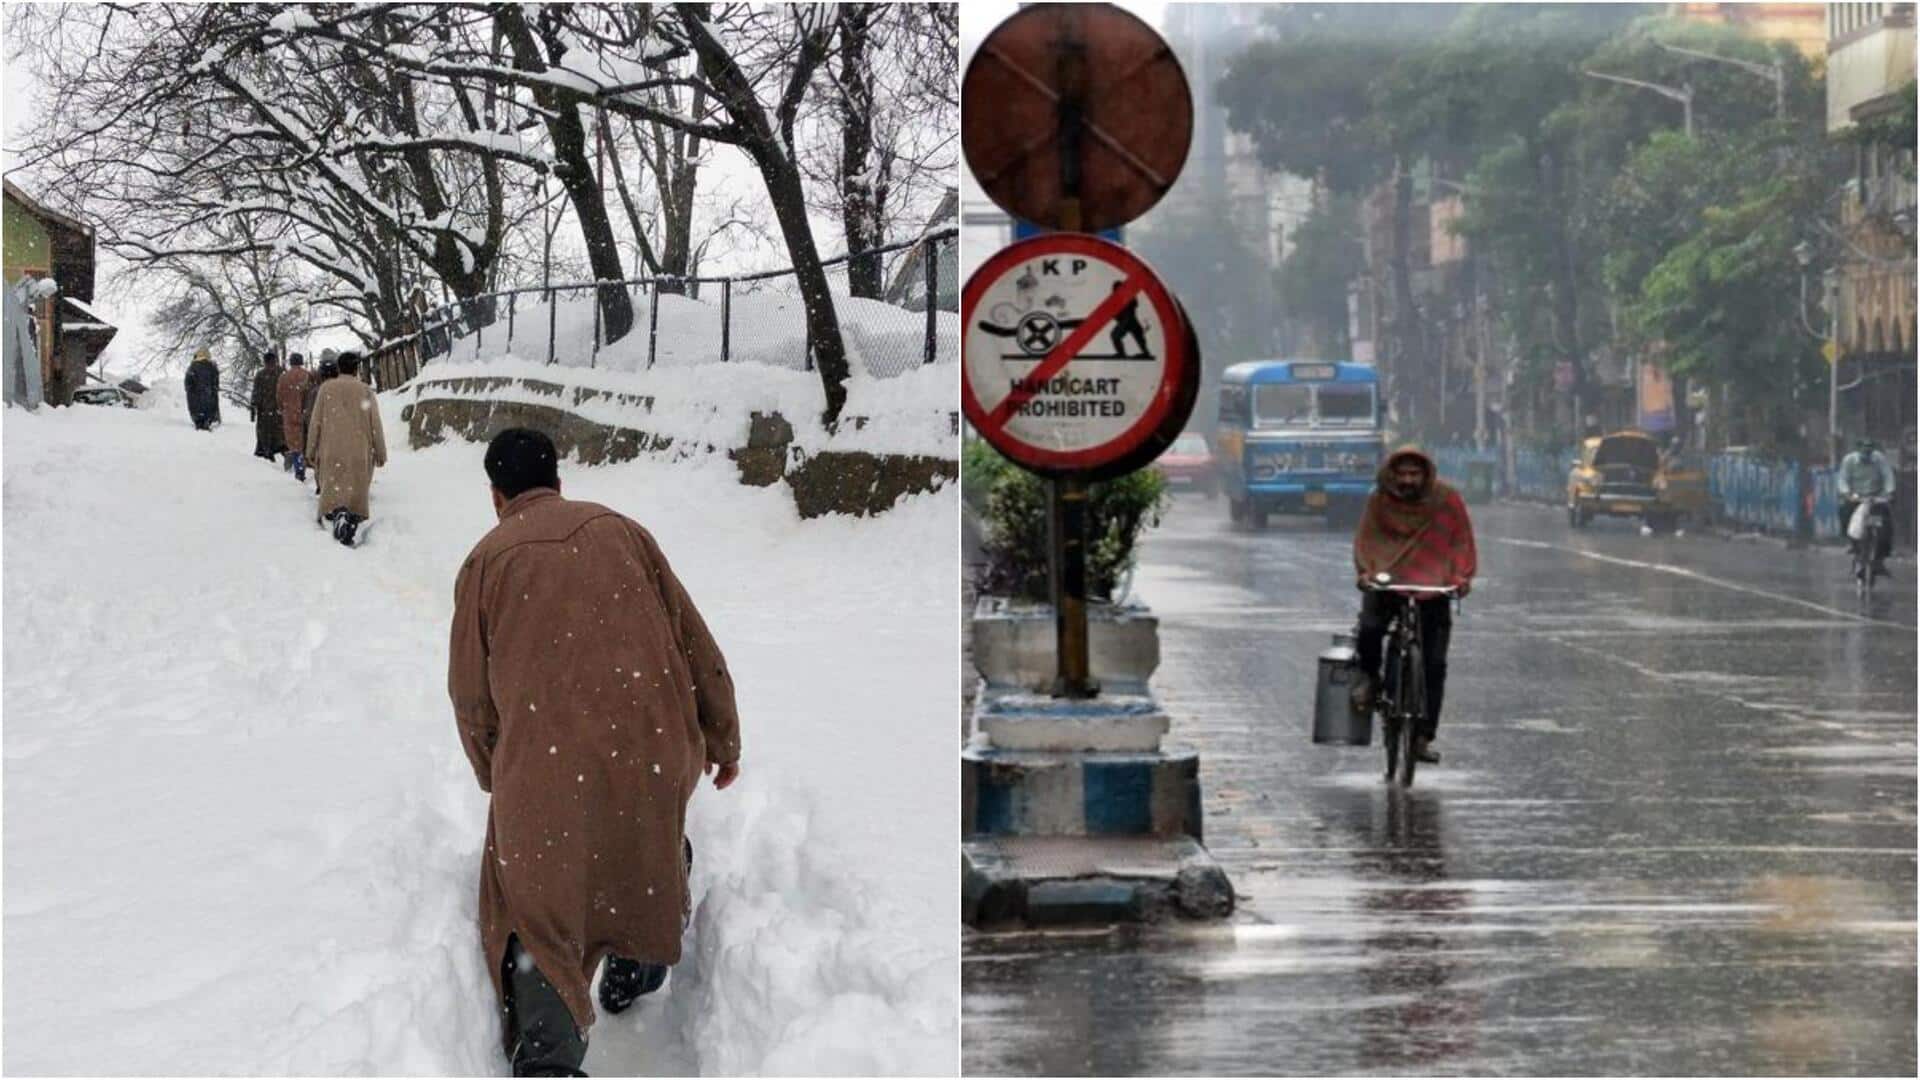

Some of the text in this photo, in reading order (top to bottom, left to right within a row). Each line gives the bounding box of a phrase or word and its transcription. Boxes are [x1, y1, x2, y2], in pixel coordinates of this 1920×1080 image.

[1043, 259, 1087, 275] K P
[1070, 379, 1120, 395] CART
[1008, 400, 1125, 416] PROHIBITED
